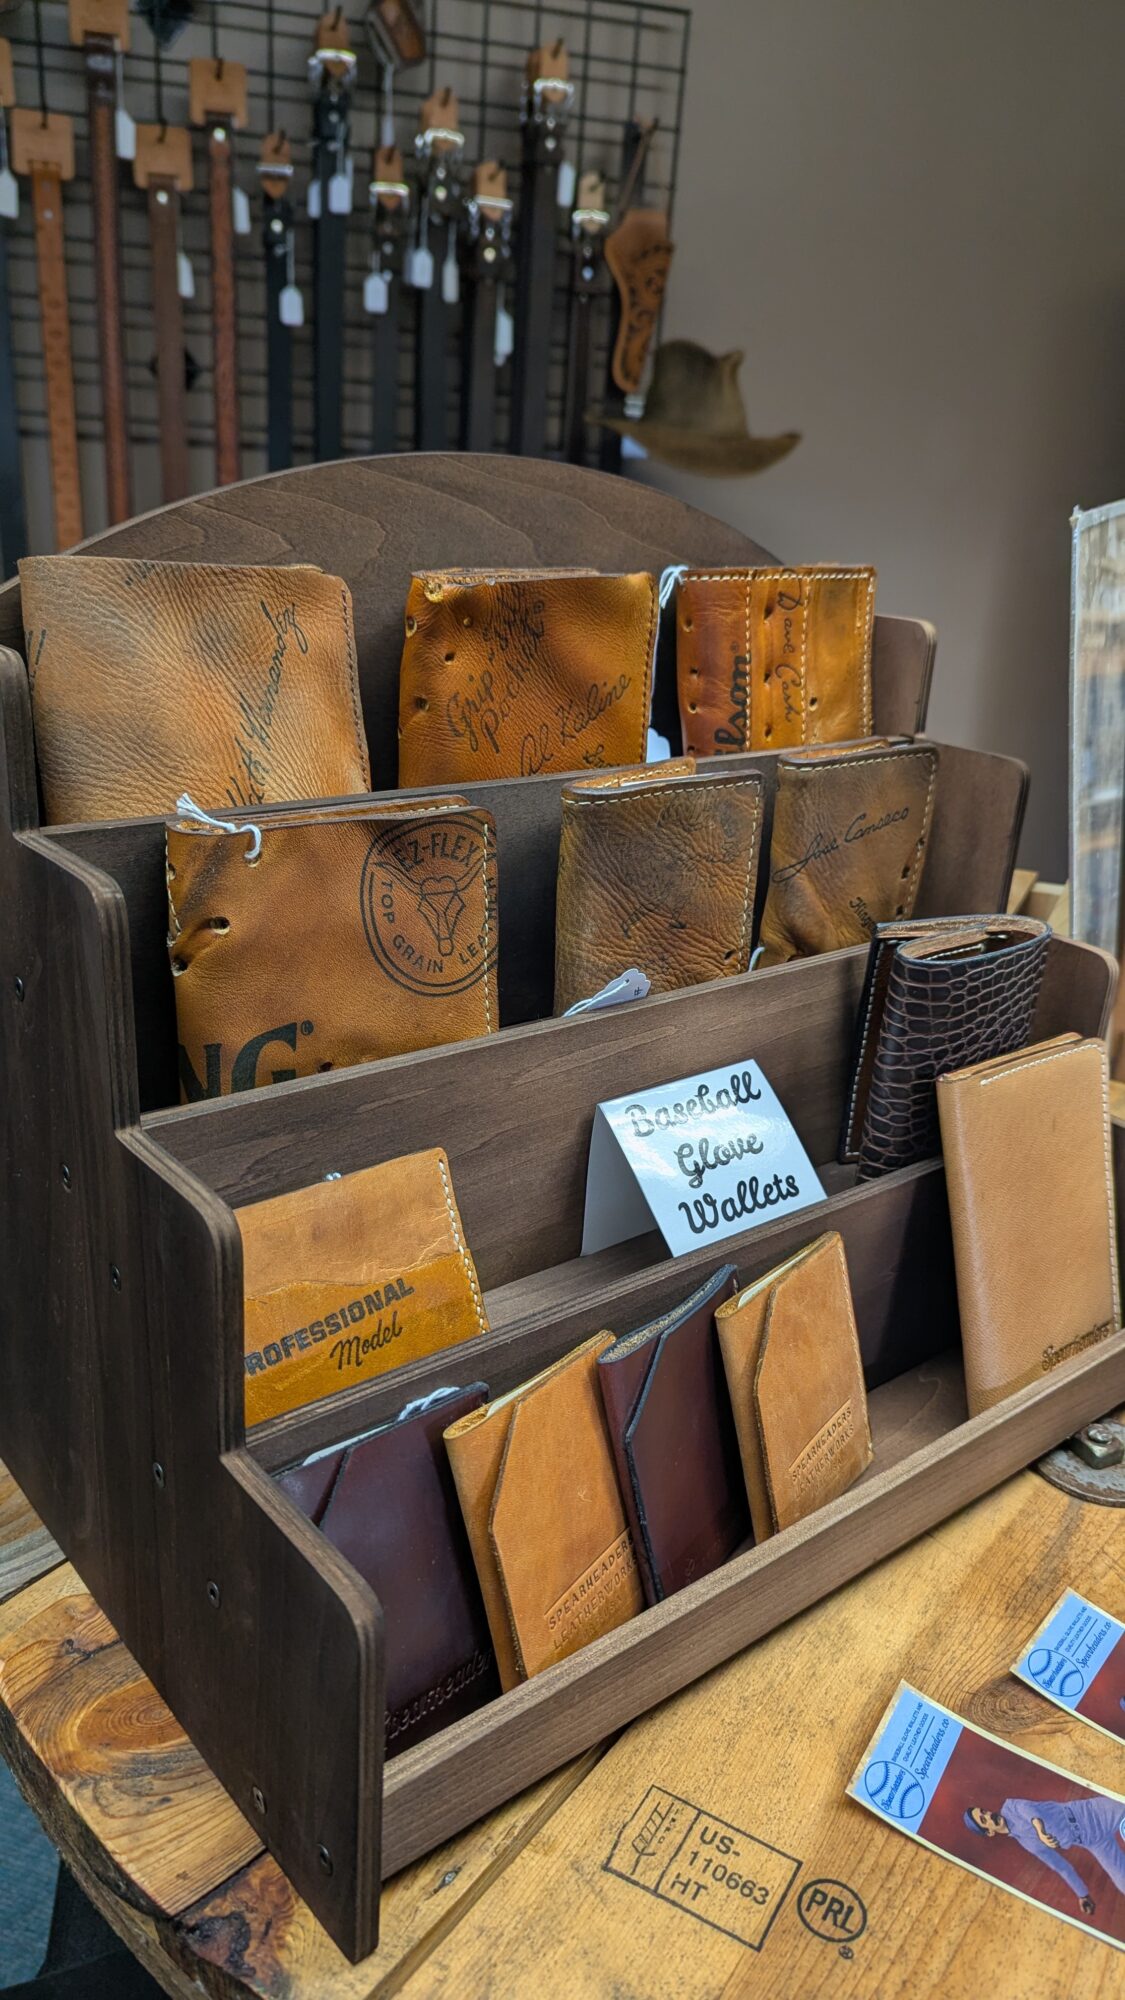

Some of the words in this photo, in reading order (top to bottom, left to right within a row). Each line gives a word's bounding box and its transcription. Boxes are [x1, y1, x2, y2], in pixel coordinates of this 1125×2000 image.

[776, 570, 806, 654] Dave
[239, 600, 309, 750] Hernandez
[714, 655, 751, 755] lson
[775, 664, 802, 723] Cash
[520, 724, 554, 776] Al
[555, 674, 632, 746] Kaline
[393, 832, 480, 872] EZ-FLEX
[844, 807, 910, 842] Canseco
[381, 879, 396, 925] TOP
[393, 934, 444, 974] GRAIN
[624, 1071, 761, 1137] Baseball
[674, 1133, 764, 1189] Glove
[678, 1173, 800, 1234] Wallets
[245, 1278, 415, 1376] ROFESSIONAL
[330, 1311, 403, 1370] Model
[791, 1407, 852, 1482] SPEARHEADERS
[548, 1537, 634, 1631] SPEARHEADERS
[669, 1873, 708, 1902] HT
[689, 1850, 770, 1906] 110663
[804, 1888, 855, 1935] PRL
